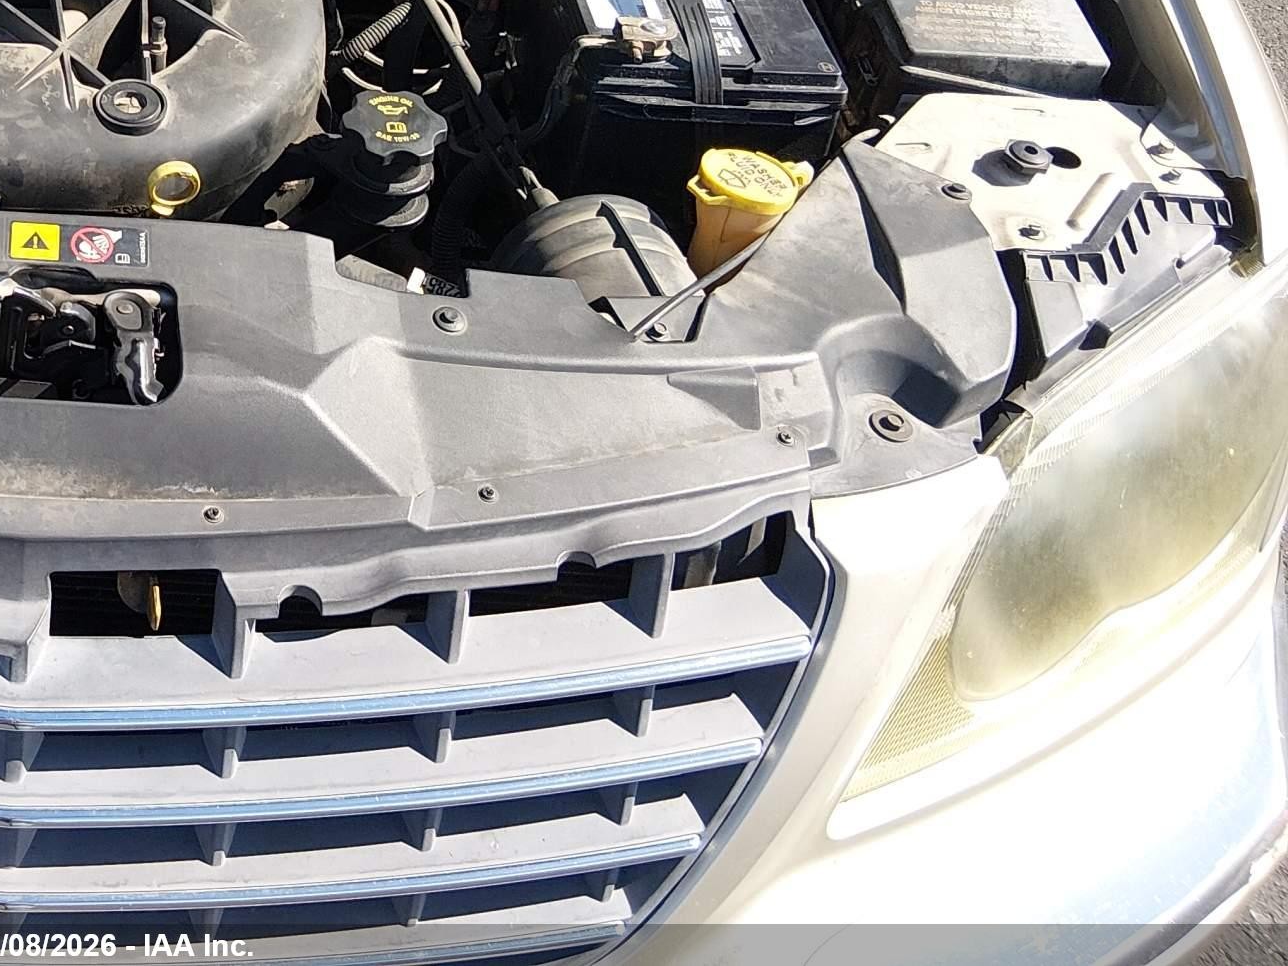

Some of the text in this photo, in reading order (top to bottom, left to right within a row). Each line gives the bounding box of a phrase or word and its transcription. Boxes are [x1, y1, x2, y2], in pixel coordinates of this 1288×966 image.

[368, 95, 414, 108] ENGINE OIL
[375, 130, 393, 142] SAE
[728, 151, 784, 198] FLUID ONLY
[742, 156, 788, 190] WASHER
